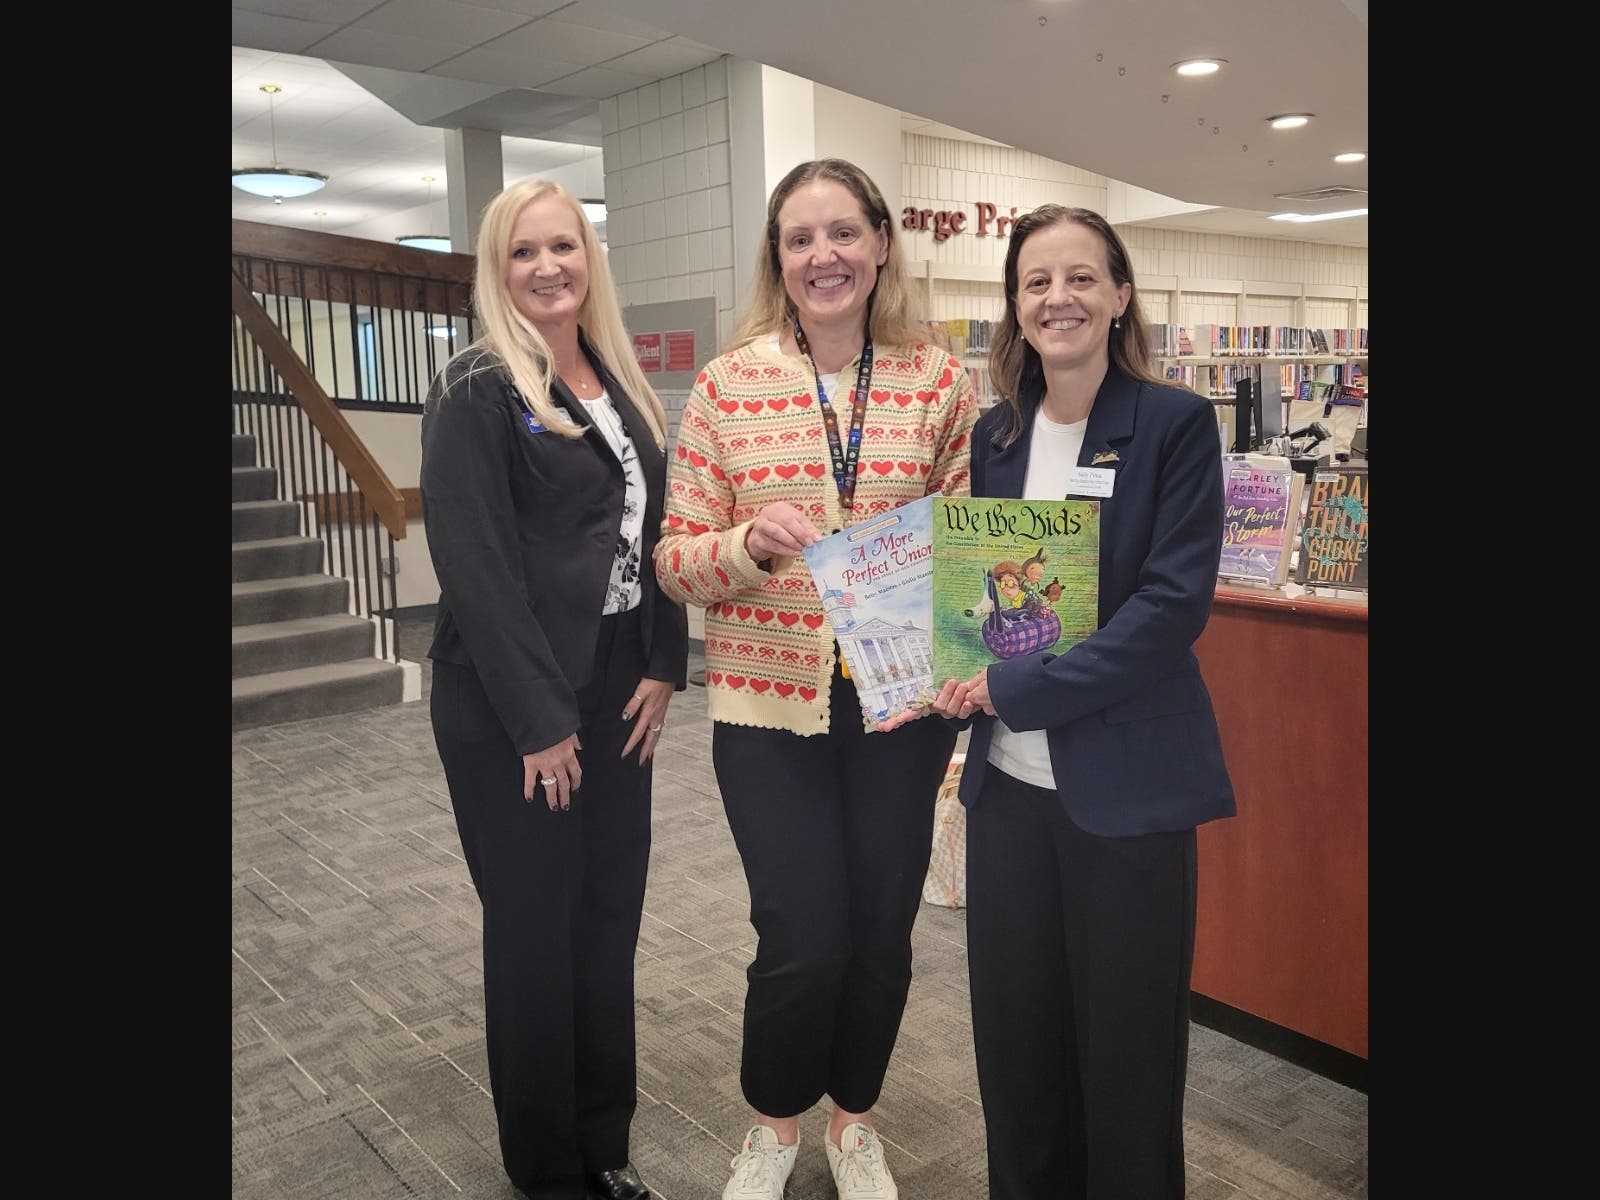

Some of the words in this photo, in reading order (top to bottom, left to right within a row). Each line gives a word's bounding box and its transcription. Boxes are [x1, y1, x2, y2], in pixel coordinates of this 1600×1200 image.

[902, 206, 967, 242] arge
[976, 202, 1018, 238] Pri
[1233, 485, 1282, 495] FORTUNE
[1312, 475, 1368, 506] BRA
[944, 500, 984, 535] We
[985, 503, 1021, 537] the
[1014, 505, 1082, 542] Kids
[1226, 505, 1245, 518] Our
[1242, 506, 1285, 524] Perfect
[1224, 521, 1274, 546] Storm
[851, 544, 867, 565] A
[872, 532, 914, 557] More
[1308, 539, 1365, 562] CHOKE
[842, 560, 889, 587] Perfect
[1307, 560, 1358, 583] POINT
